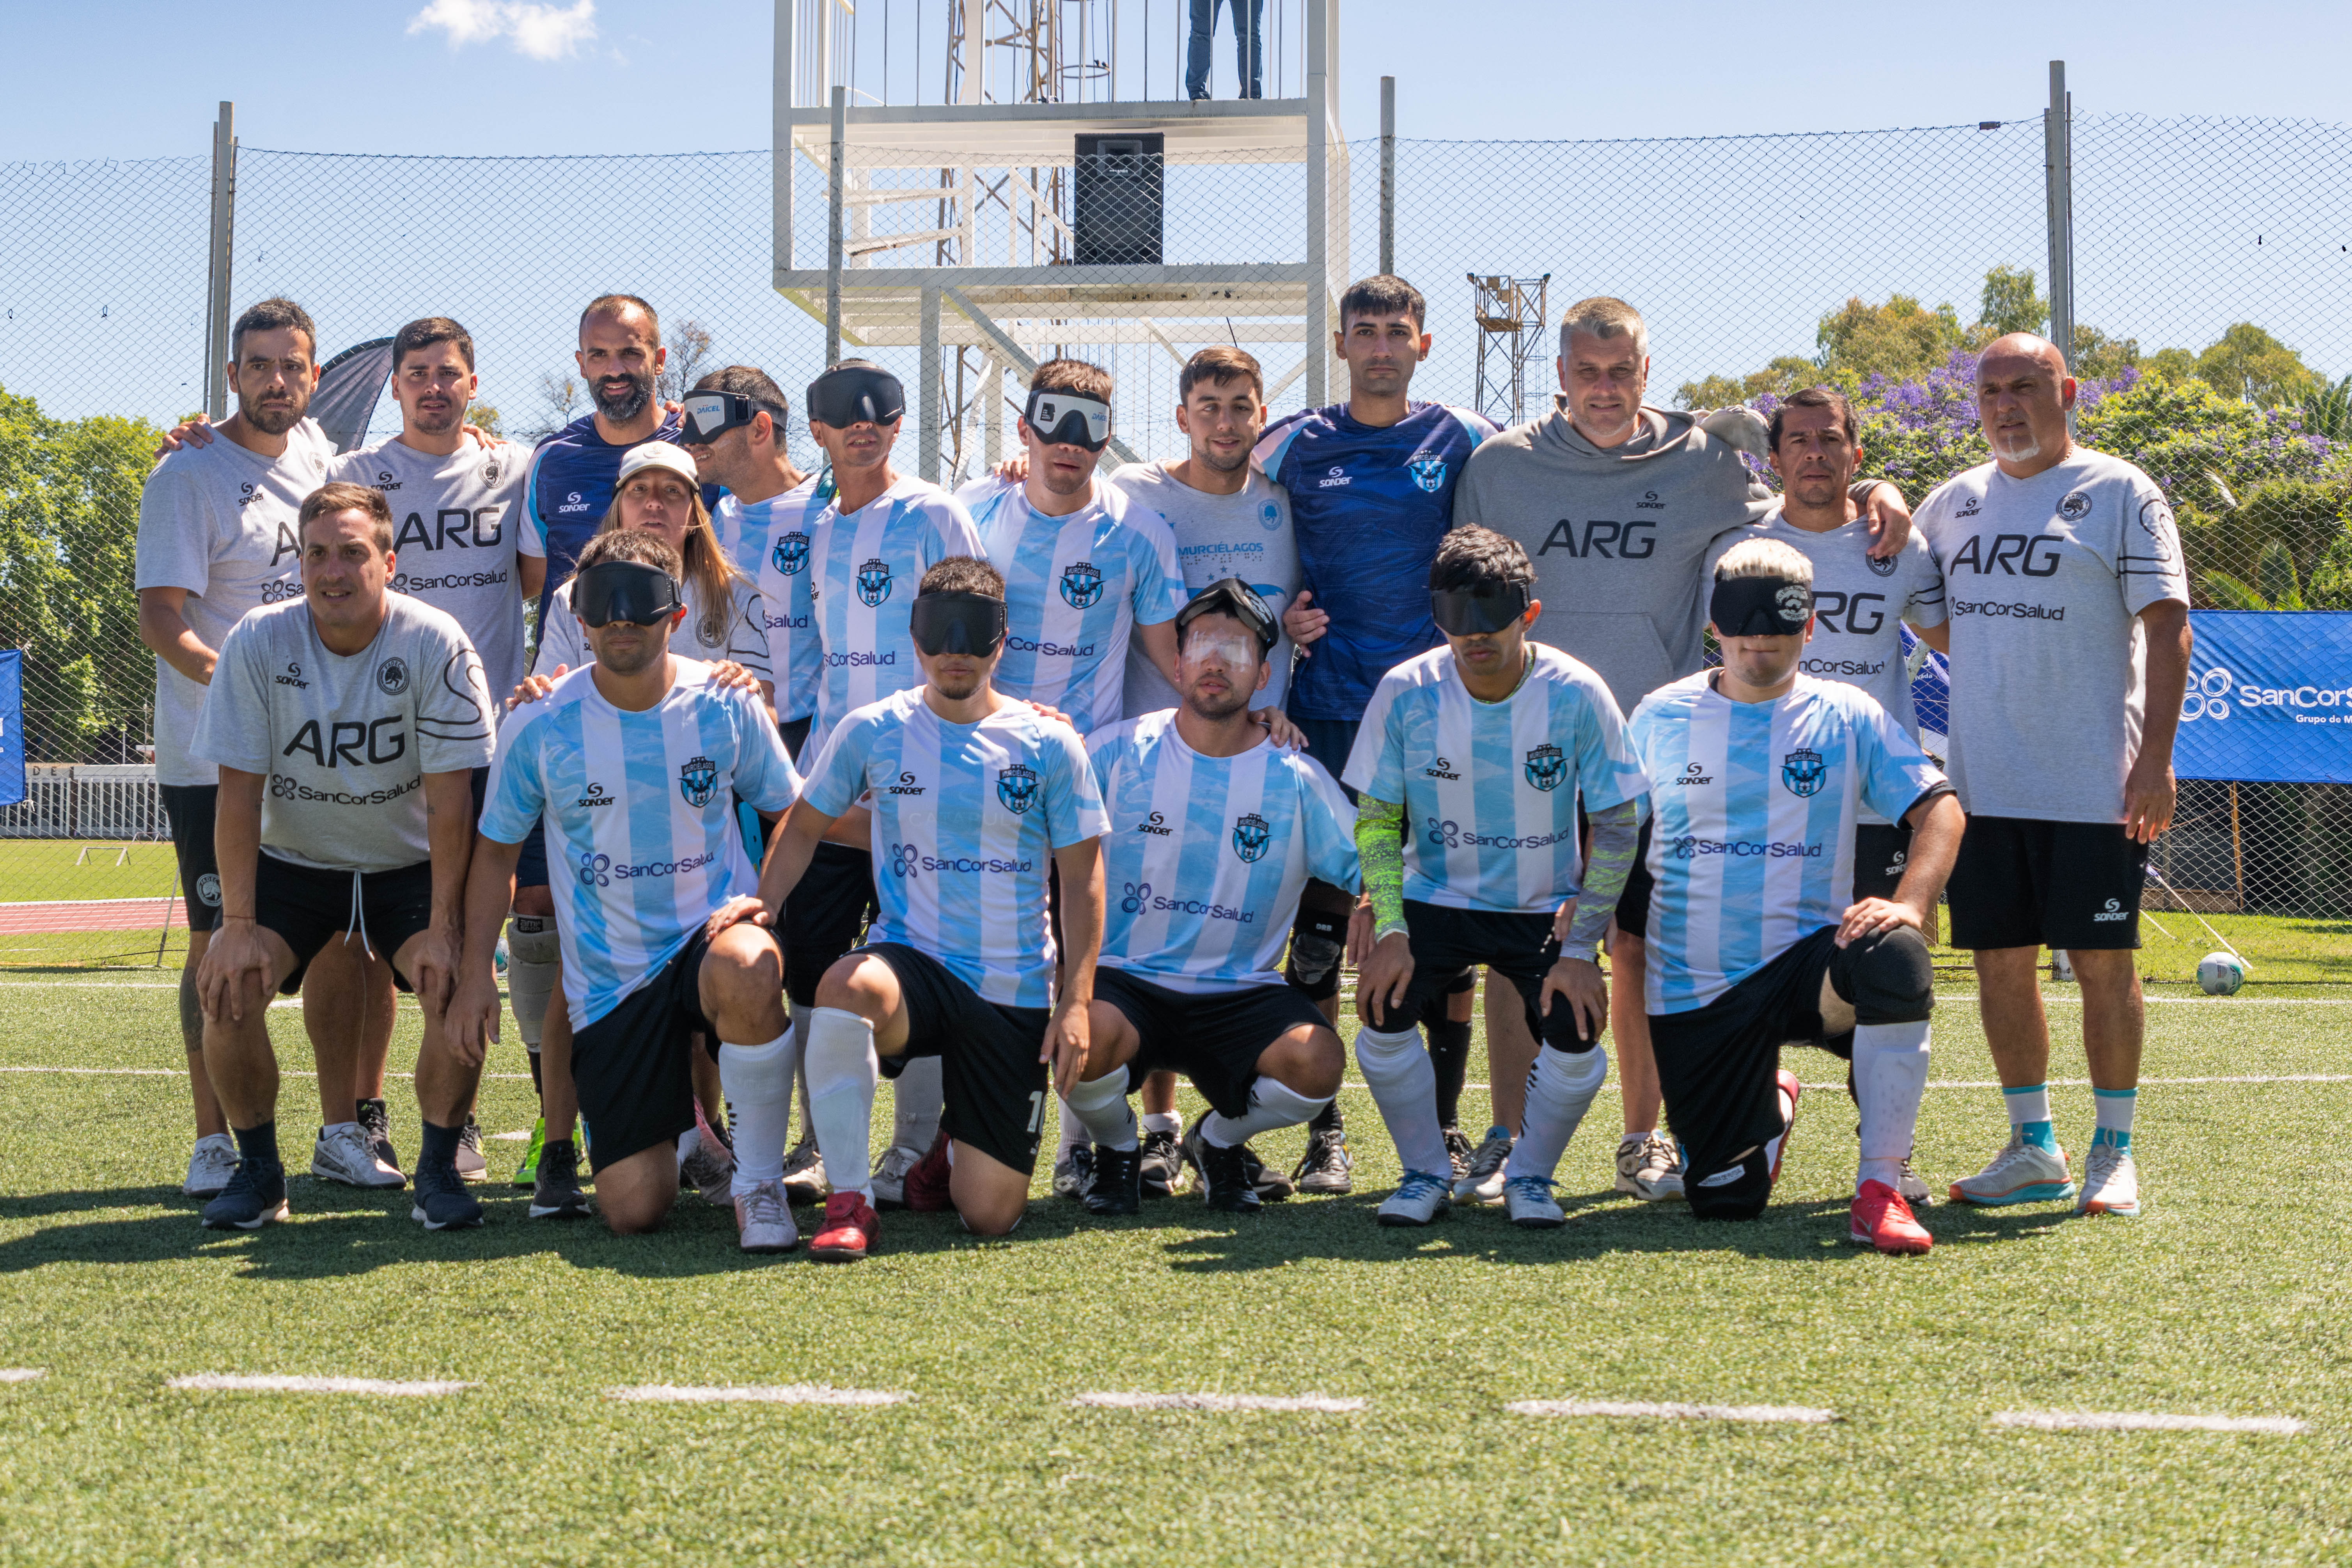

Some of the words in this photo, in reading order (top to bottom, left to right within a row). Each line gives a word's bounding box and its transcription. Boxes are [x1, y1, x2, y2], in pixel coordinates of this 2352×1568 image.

[394, 507, 502, 554] ARG
[1536, 519, 1657, 559] ARG
[780, 536, 808, 545] MURCIÉLAGOS
[1178, 542, 1264, 556] MURCIÉLAGOS
[1950, 535, 2065, 577] ARG
[409, 571, 507, 592] SanCorSalud
[1067, 567, 1100, 577] MURCIÉLAGOS
[1814, 591, 1886, 635] RG
[1955, 604, 2065, 621] SanCorSalud
[384, 661, 402, 670] FADEC
[1799, 660, 1885, 676] nCorSalud
[2295, 714, 2327, 725] Grupo
[2329, 715, 2341, 723] de
[283, 714, 405, 768] ARG
[684, 763, 714, 774] MURCIÉLAGOS
[1002, 769, 1034, 780] MURCIÉLAGOS
[298, 775, 421, 805] SanCorSalud
[1463, 827, 1569, 849] SanCorSalud
[1698, 841, 1822, 857] SanCorSalud
[615, 852, 715, 880] SanCorSalud
[922, 857, 1032, 873] SanCorSalud
[1153, 897, 1254, 924] SanCorSalud
[1027, 1091, 1046, 1135] 1
